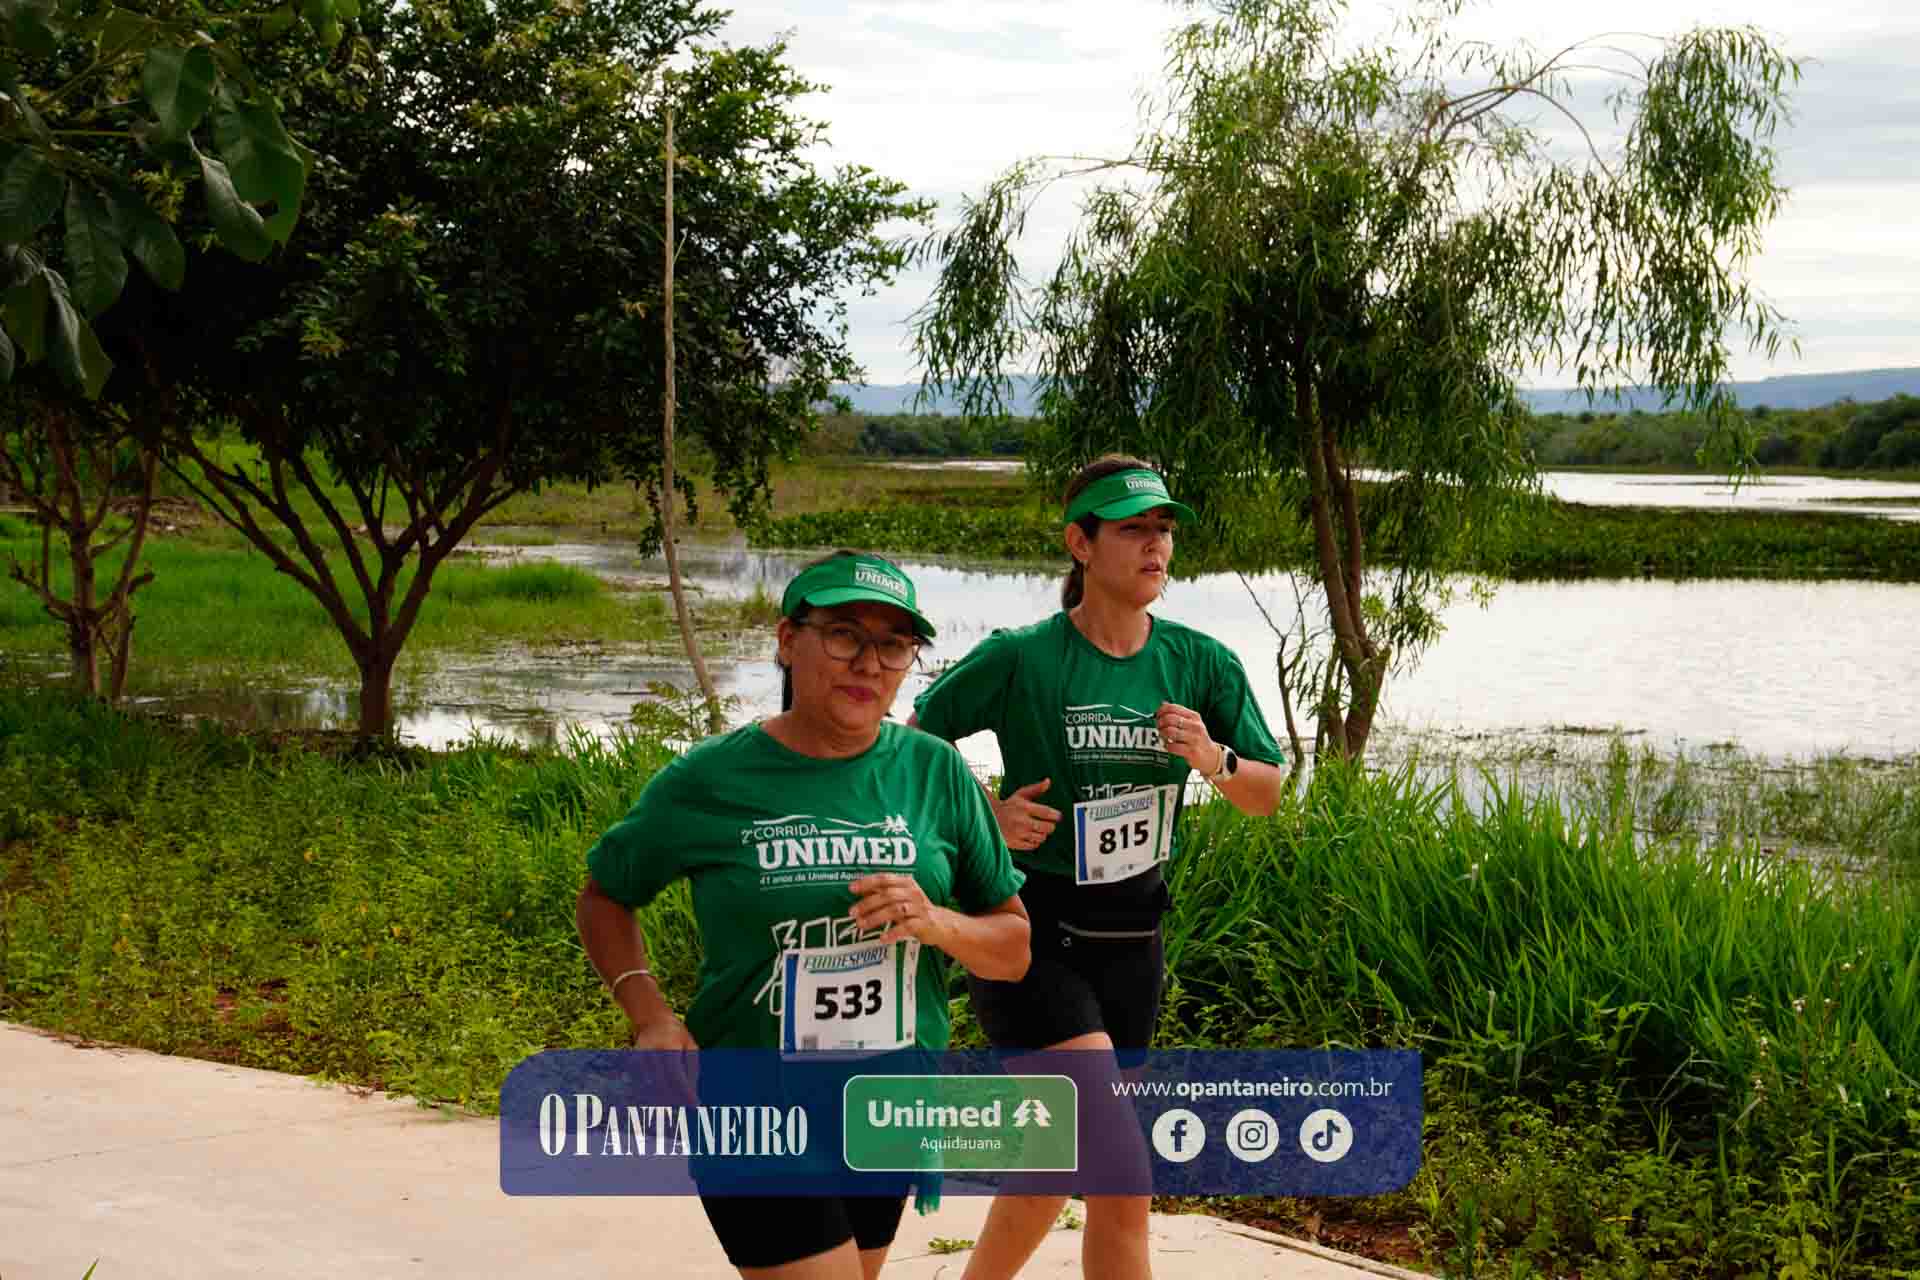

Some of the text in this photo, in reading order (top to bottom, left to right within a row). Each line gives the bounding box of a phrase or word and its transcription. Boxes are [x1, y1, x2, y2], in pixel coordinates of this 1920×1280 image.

[1064, 712, 1113, 725] CORRIDA
[1065, 725, 1163, 751] UNIME
[753, 823, 819, 841] CORRIDA
[1099, 819, 1149, 855] 815
[755, 836, 917, 870] UNIMED
[814, 979, 883, 1021] 533
